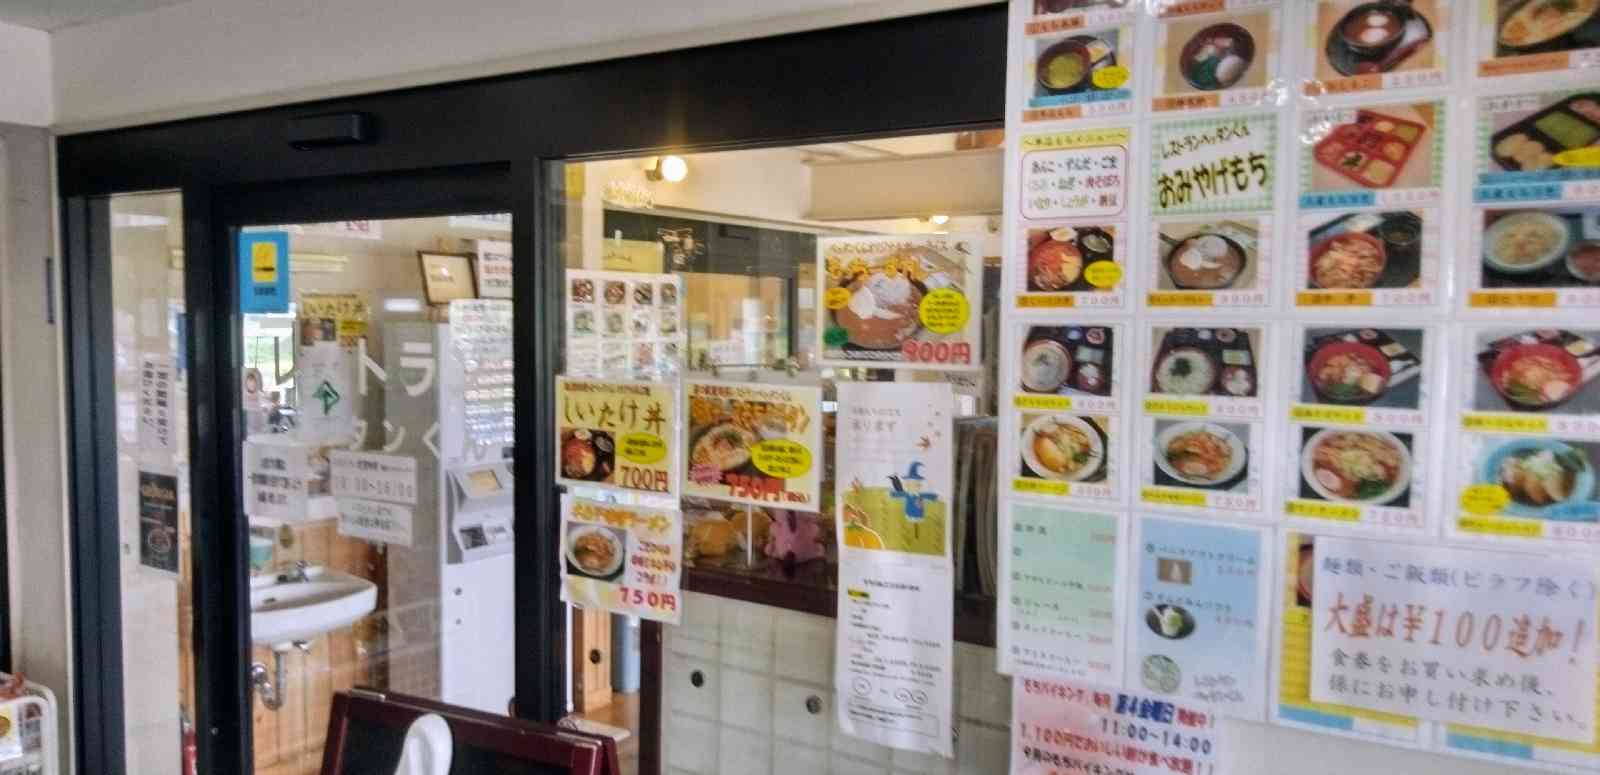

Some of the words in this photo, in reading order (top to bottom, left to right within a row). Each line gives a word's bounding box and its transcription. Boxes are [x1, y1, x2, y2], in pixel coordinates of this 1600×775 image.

[1157, 152, 1265, 208] おみやげもち
[564, 399, 667, 434] しいたけ丼
[620, 465, 669, 491] 700円
[619, 586, 676, 611] 750円
